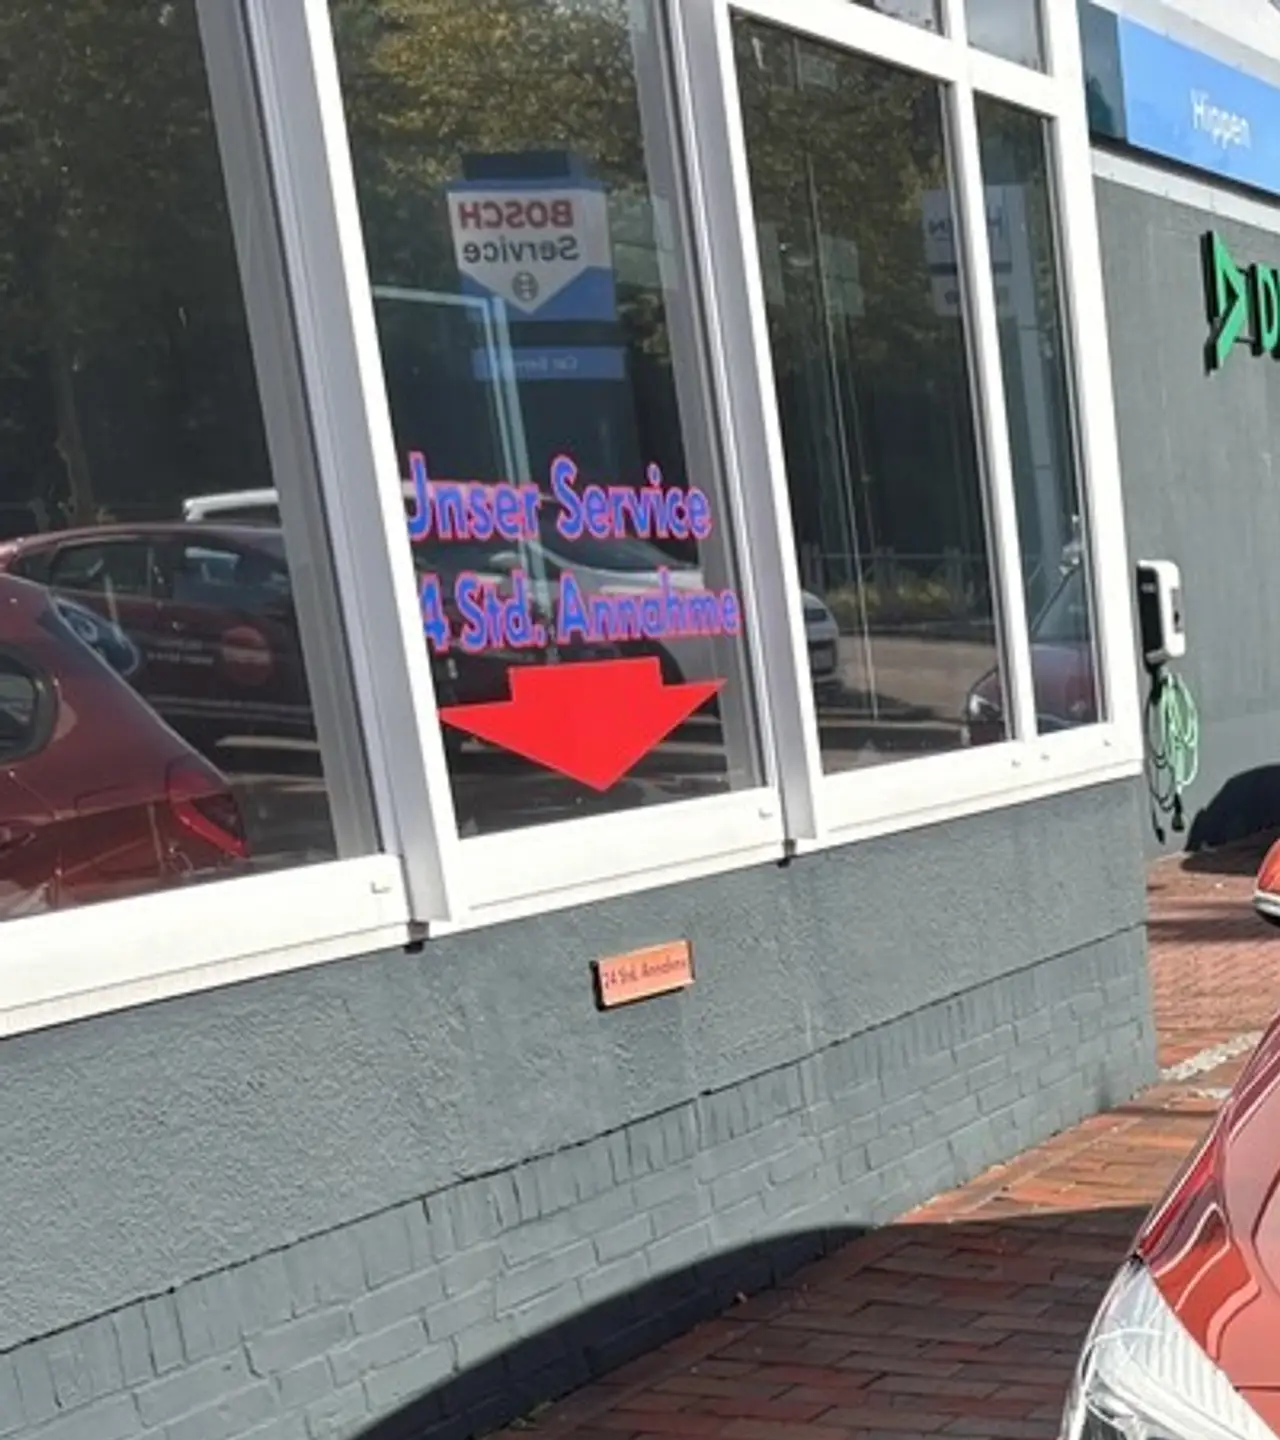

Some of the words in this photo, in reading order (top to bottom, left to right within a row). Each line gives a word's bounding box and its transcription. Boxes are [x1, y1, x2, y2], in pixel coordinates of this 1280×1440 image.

[551, 456, 712, 541] Service
[454, 569, 546, 652] Std.
[557, 565, 742, 645] Annahme
